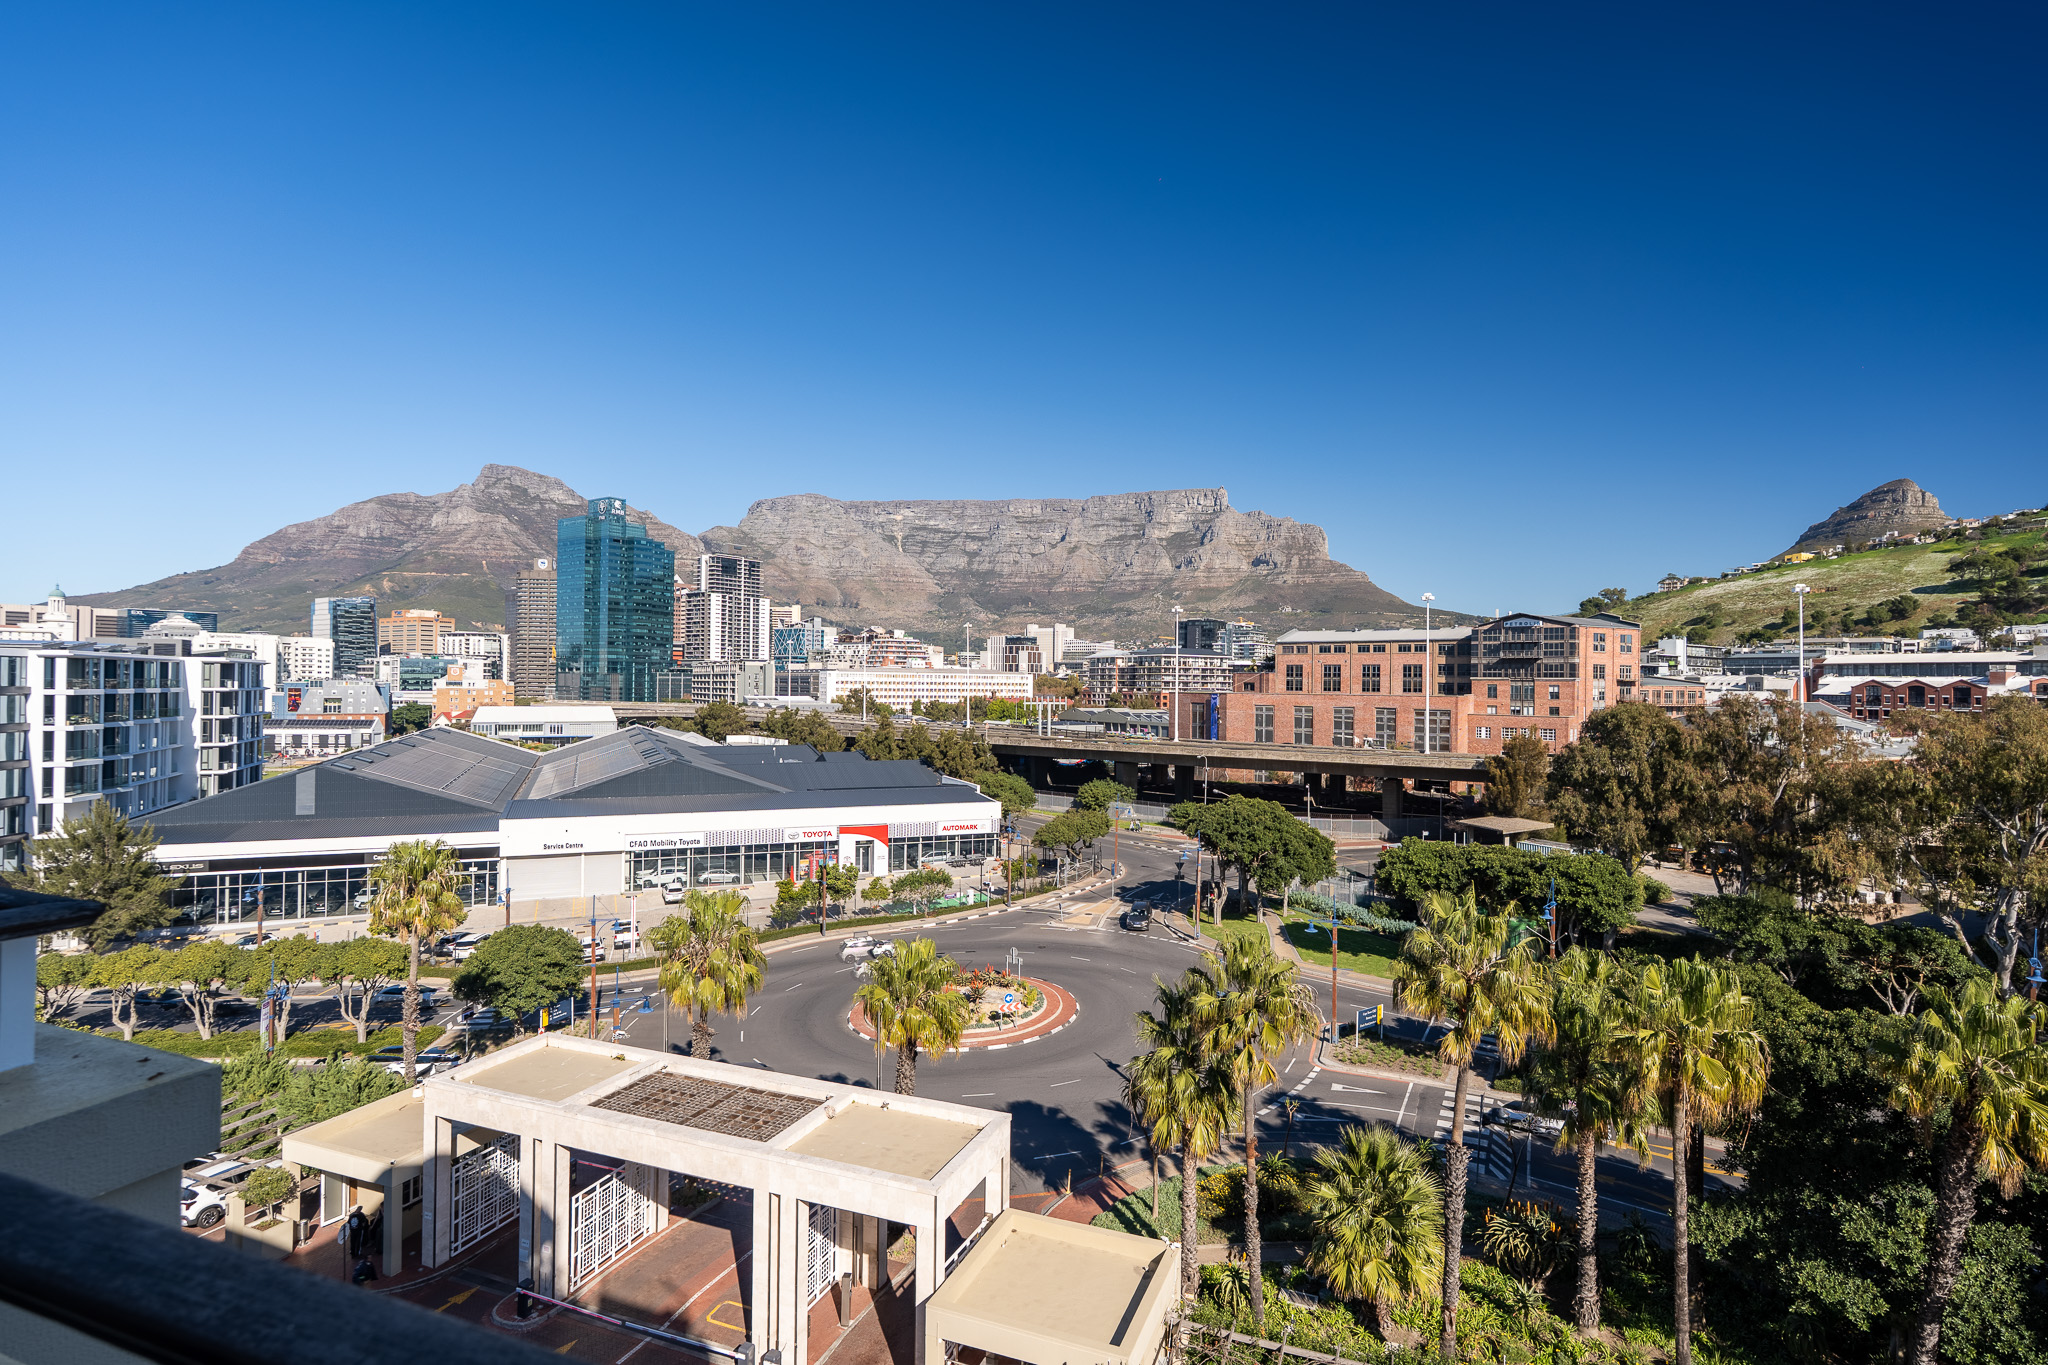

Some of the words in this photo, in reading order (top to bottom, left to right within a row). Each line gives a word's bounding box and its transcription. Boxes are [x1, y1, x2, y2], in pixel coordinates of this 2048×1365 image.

[611, 508, 625, 516] RMB
[942, 824, 978, 832] AUTOMARK
[802, 830, 833, 838] TOYOTA
[629, 840, 648, 848] CFAO
[650, 838, 678, 848] Mobility
[679, 837, 701, 846] Toyota
[162, 863, 205, 871] LEXUS
